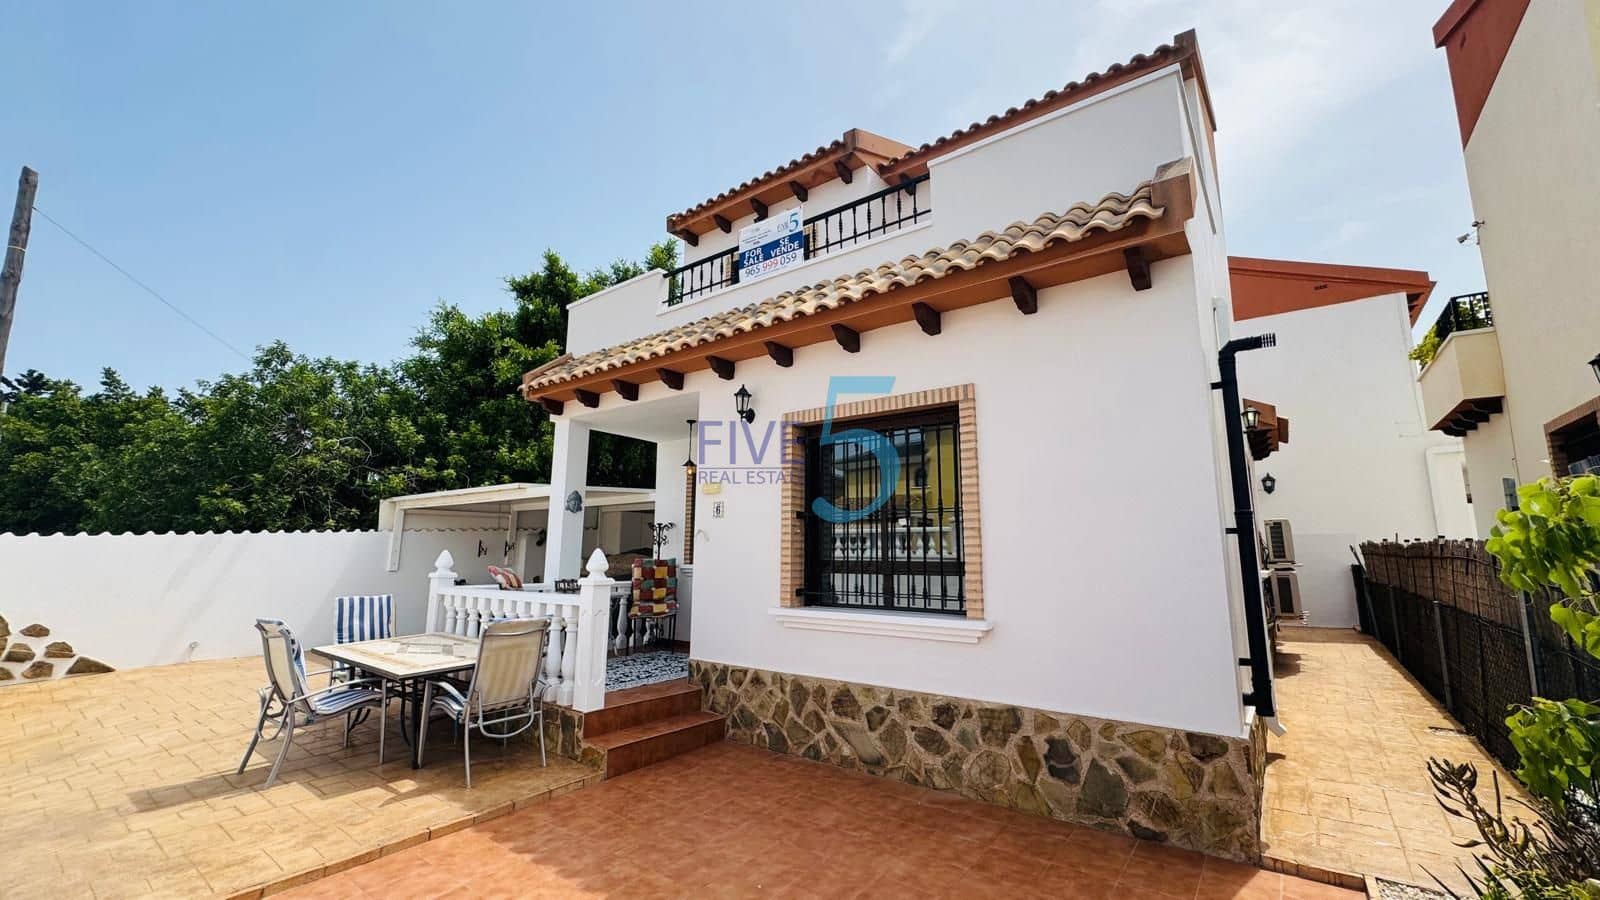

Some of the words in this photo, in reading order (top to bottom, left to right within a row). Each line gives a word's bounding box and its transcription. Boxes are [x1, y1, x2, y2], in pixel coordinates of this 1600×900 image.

[789, 212, 799, 232] 5
[770, 240, 800, 258] VENDE
[779, 236, 790, 246] SE
[743, 254, 764, 268] SALE
[745, 247, 762, 259] FOR
[745, 264, 761, 277] 965
[762, 258, 779, 271] 999
[780, 252, 797, 265] 059
